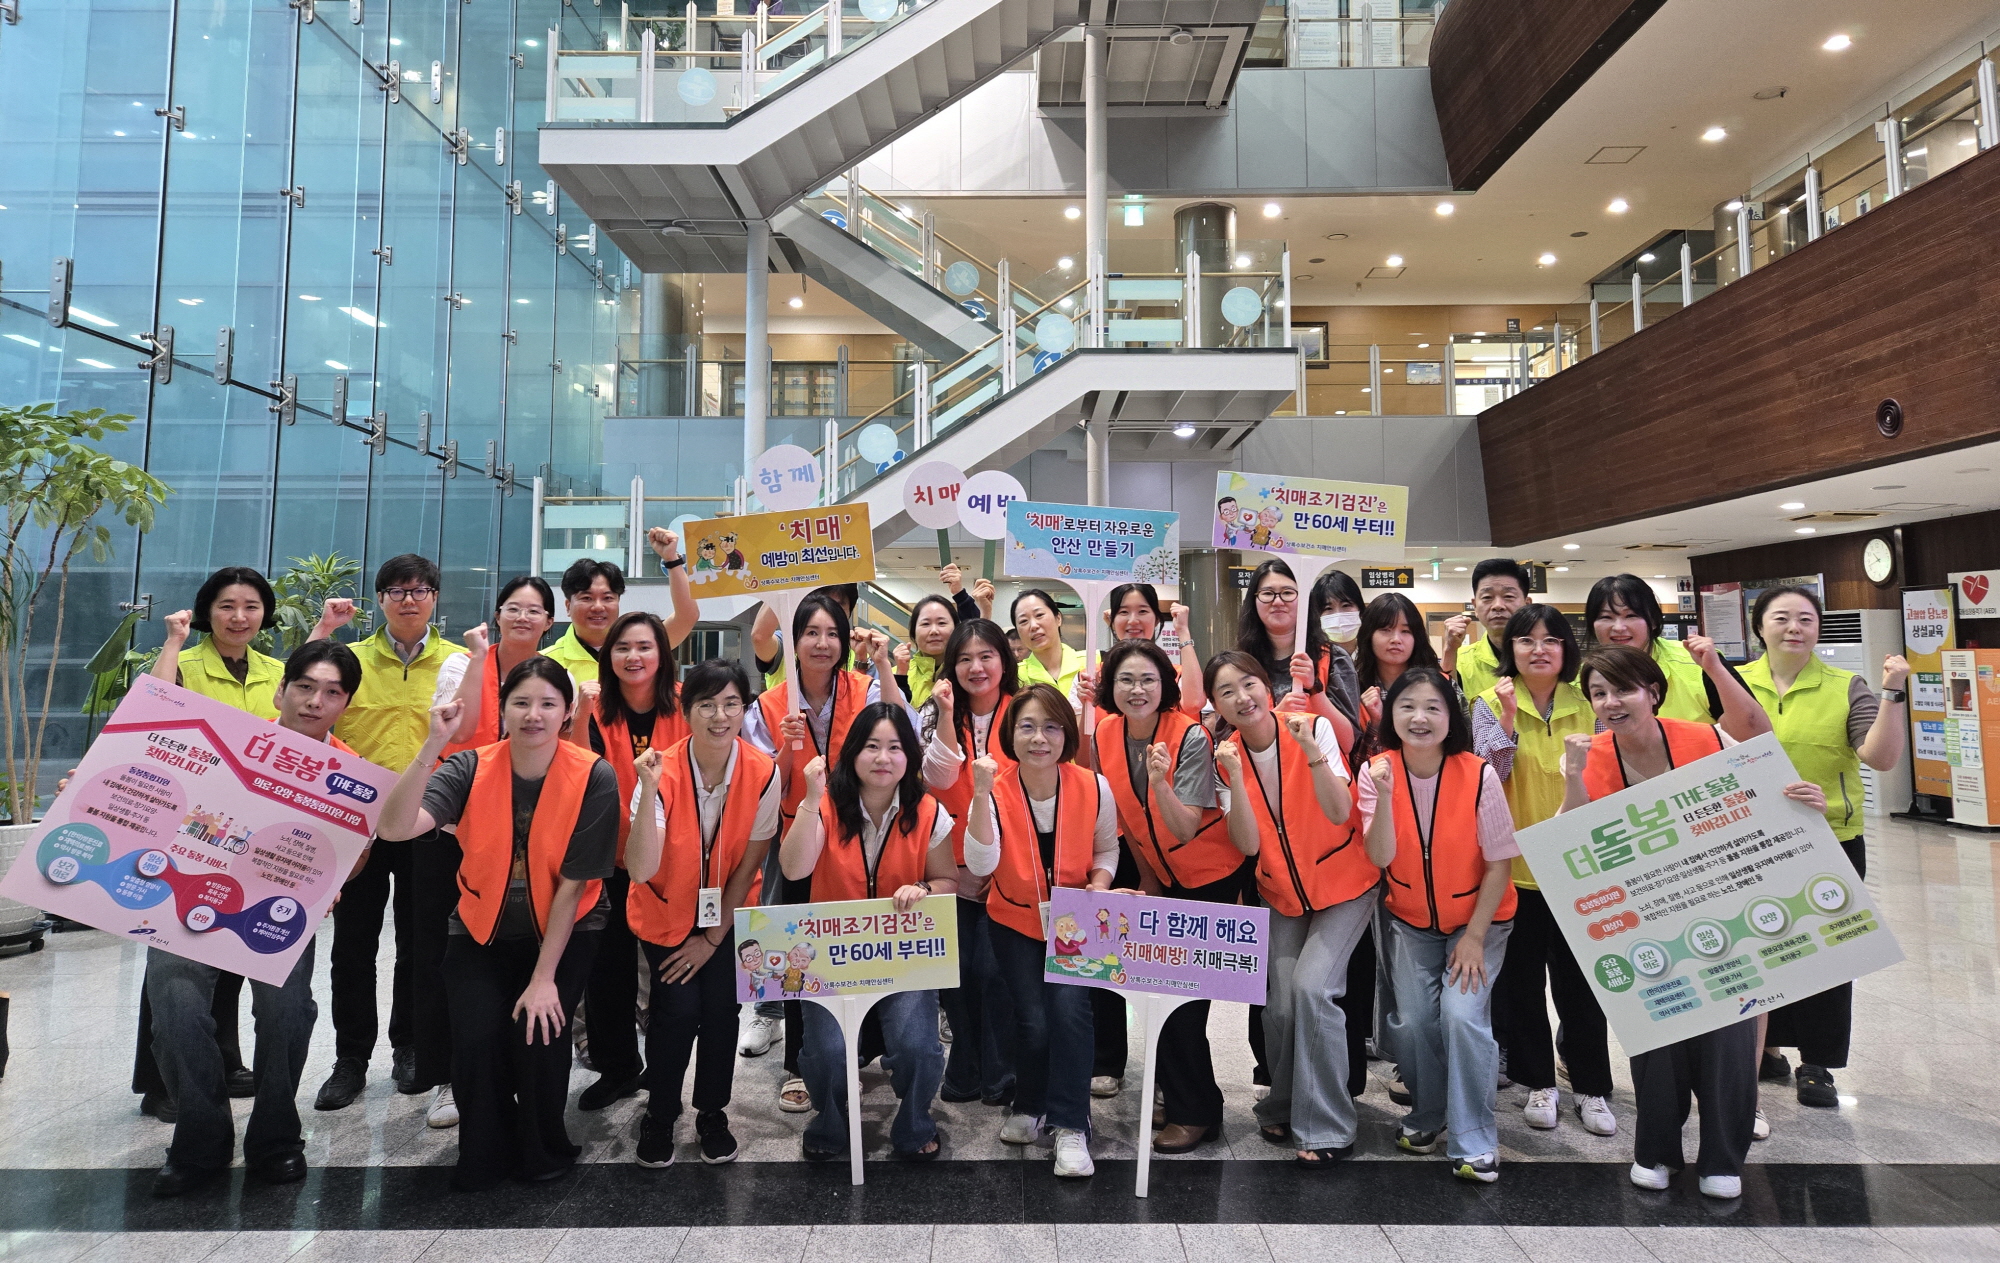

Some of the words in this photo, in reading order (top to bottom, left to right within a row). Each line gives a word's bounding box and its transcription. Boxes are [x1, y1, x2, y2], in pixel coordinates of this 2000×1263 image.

[759, 463, 815, 494] 함께
[913, 482, 962, 505] 치매
[1104, 521, 1154, 537] 자유로운
[1294, 512, 1310, 530] 만
[1312, 515, 1348, 533] 60세
[1352, 518, 1394, 536] 부터!!
[1051, 537, 1082, 555] 안산
[1088, 539, 1134, 558] 만들기
[1317, 544, 1347, 552] 치매안심센터
[761, 551, 798, 569] 예방이
[802, 546, 860, 563] 최선입니다.
[761, 578, 790, 586] 상록수보건소
[791, 574, 820, 583] 치매안심센터
[1101, 569, 1128, 577] 치매안심센터
[1369, 571, 1394, 579] 임상병리
[1906, 608, 1926, 620] 고혈압
[1928, 608, 1948, 620] 당뇨병
[1912, 624, 1944, 638] 상설교육
[147, 732, 158, 743] 더
[159, 736, 188, 754] 든든한
[187, 746, 221, 766] 돌봄이
[145, 745, 208, 776] 찾아갑니다!
[243, 733, 276, 764] 더
[273, 746, 325, 782] 돌봄
[333, 775, 354, 792] THE
[352, 784, 374, 800] 돌봄
[1669, 785, 1708, 810] THE
[1704, 773, 1740, 798] 돌봄
[1683, 813, 1694, 823] 더
[1694, 801, 1723, 819] 든든한
[1722, 788, 1757, 808] 돌봄이
[342, 813, 362, 826] 사업
[1689, 805, 1752, 837] 찾아갑니다!
[149, 853, 165, 865] 일상
[170, 844, 186, 855] 주요
[187, 850, 205, 861] 돌봄
[204, 857, 228, 871] 서비스
[1624, 875, 1643, 887] 돌봄이
[1643, 868, 1662, 881] 필요한
[1662, 861, 1682, 873] 사람이
[1681, 858, 1689, 866] 내
[1688, 851, 1708, 863] 집에서
[1708, 840, 1735, 858] 건강하게
[1732, 829, 1765, 848] 살아가도록
[58, 859, 75, 871] 보건
[1683, 886, 1697, 895] 사고
[1728, 865, 1755, 882] 일상생활
[1754, 857, 1775, 871] 유지에
[1773, 847, 1800, 862] 어려움이
[1799, 841, 1814, 852] 있어
[51, 868, 70, 880] 의료
[1820, 890, 1839, 901] 주거
[275, 905, 291, 915] 주거
[192, 913, 210, 924] 요양
[1760, 912, 1778, 925] 요양
[1139, 910, 1159, 935] 다
[1168, 912, 1208, 941] 함께
[1216, 918, 1258, 944] 해요
[1602, 920, 1624, 932] 대상자
[1696, 929, 1715, 942] 일상
[1701, 938, 1720, 950] 생활
[829, 945, 848, 966] 만
[850, 942, 892, 961] 60세
[897, 938, 945, 960] 부터!!
[1123, 941, 1187, 966] 치매예방!
[1193, 949, 1258, 973] 치매극복!
[1637, 950, 1655, 962] 보건
[1601, 958, 1617, 969] 주요
[1643, 959, 1660, 971] 의료
[824, 981, 858, 989] 상록수보건소
[860, 978, 894, 986] 치매안심센터
[1129, 975, 1163, 985] 상록수보건소
[1165, 980, 1200, 989] 치매안심센터
[1758, 992, 1784, 1007] 안산시
